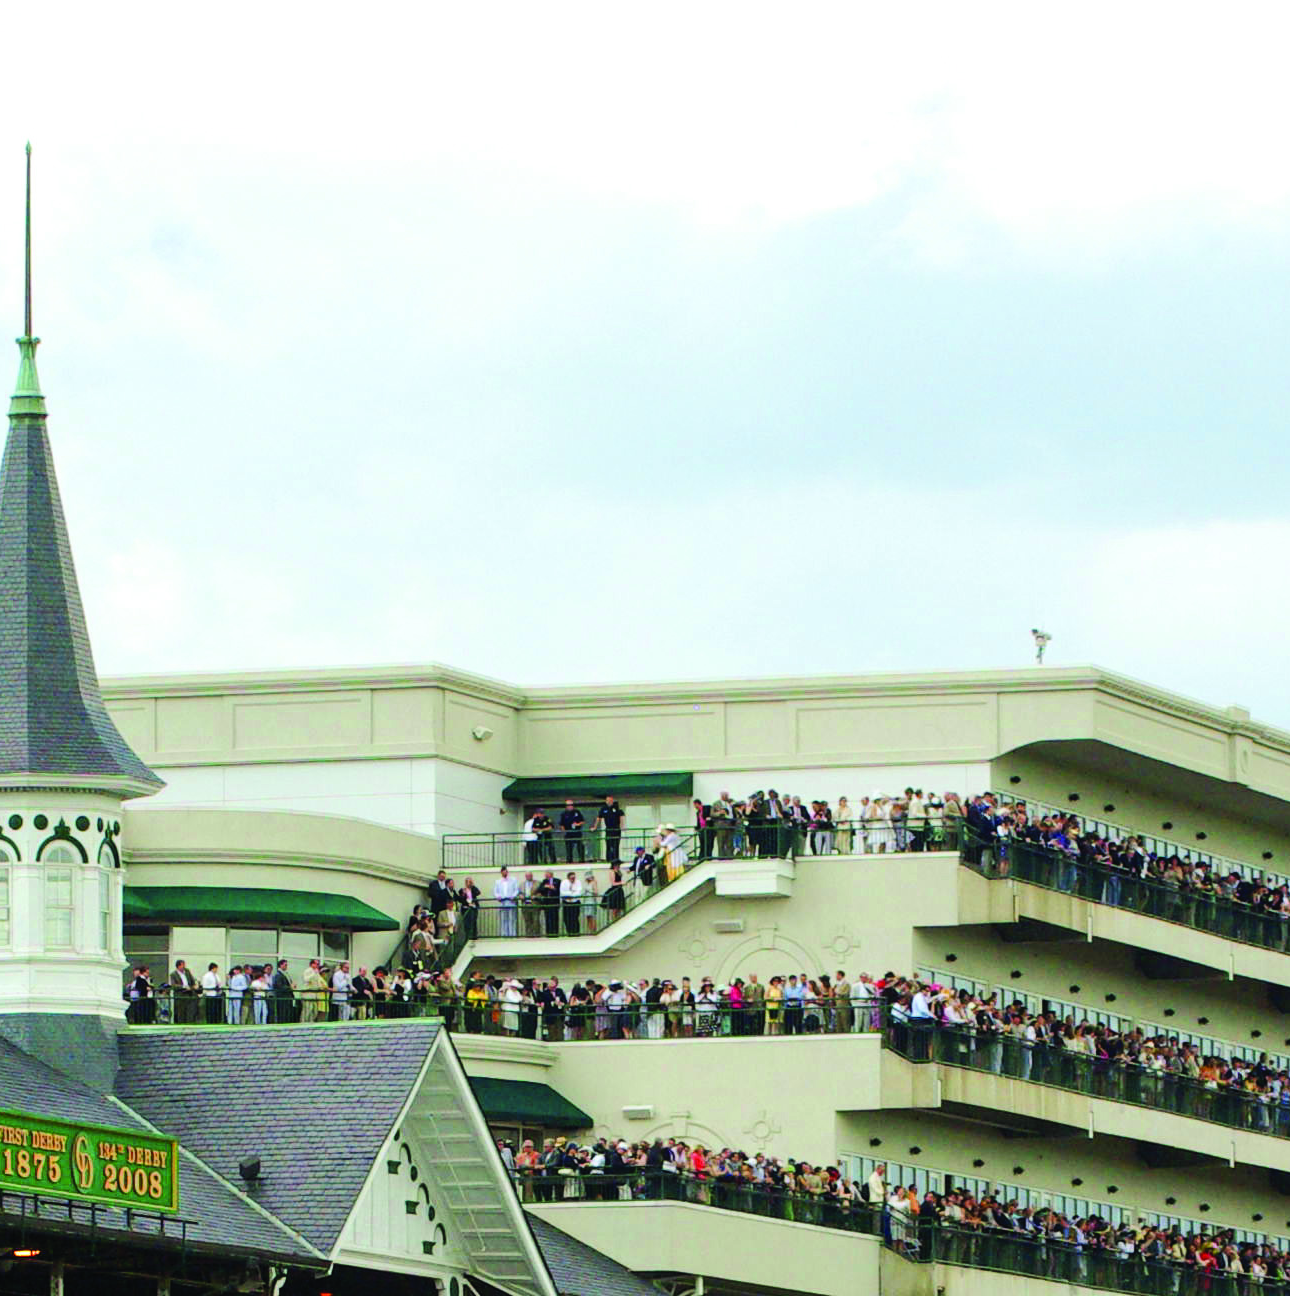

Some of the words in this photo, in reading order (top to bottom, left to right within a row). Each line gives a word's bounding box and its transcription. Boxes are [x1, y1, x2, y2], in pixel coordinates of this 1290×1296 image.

[32, 1130, 67, 1153] DERBY
[3, 1148, 62, 1183] 1875
[128, 1146, 168, 1169] DERBY
[103, 1163, 162, 1199] 2008
